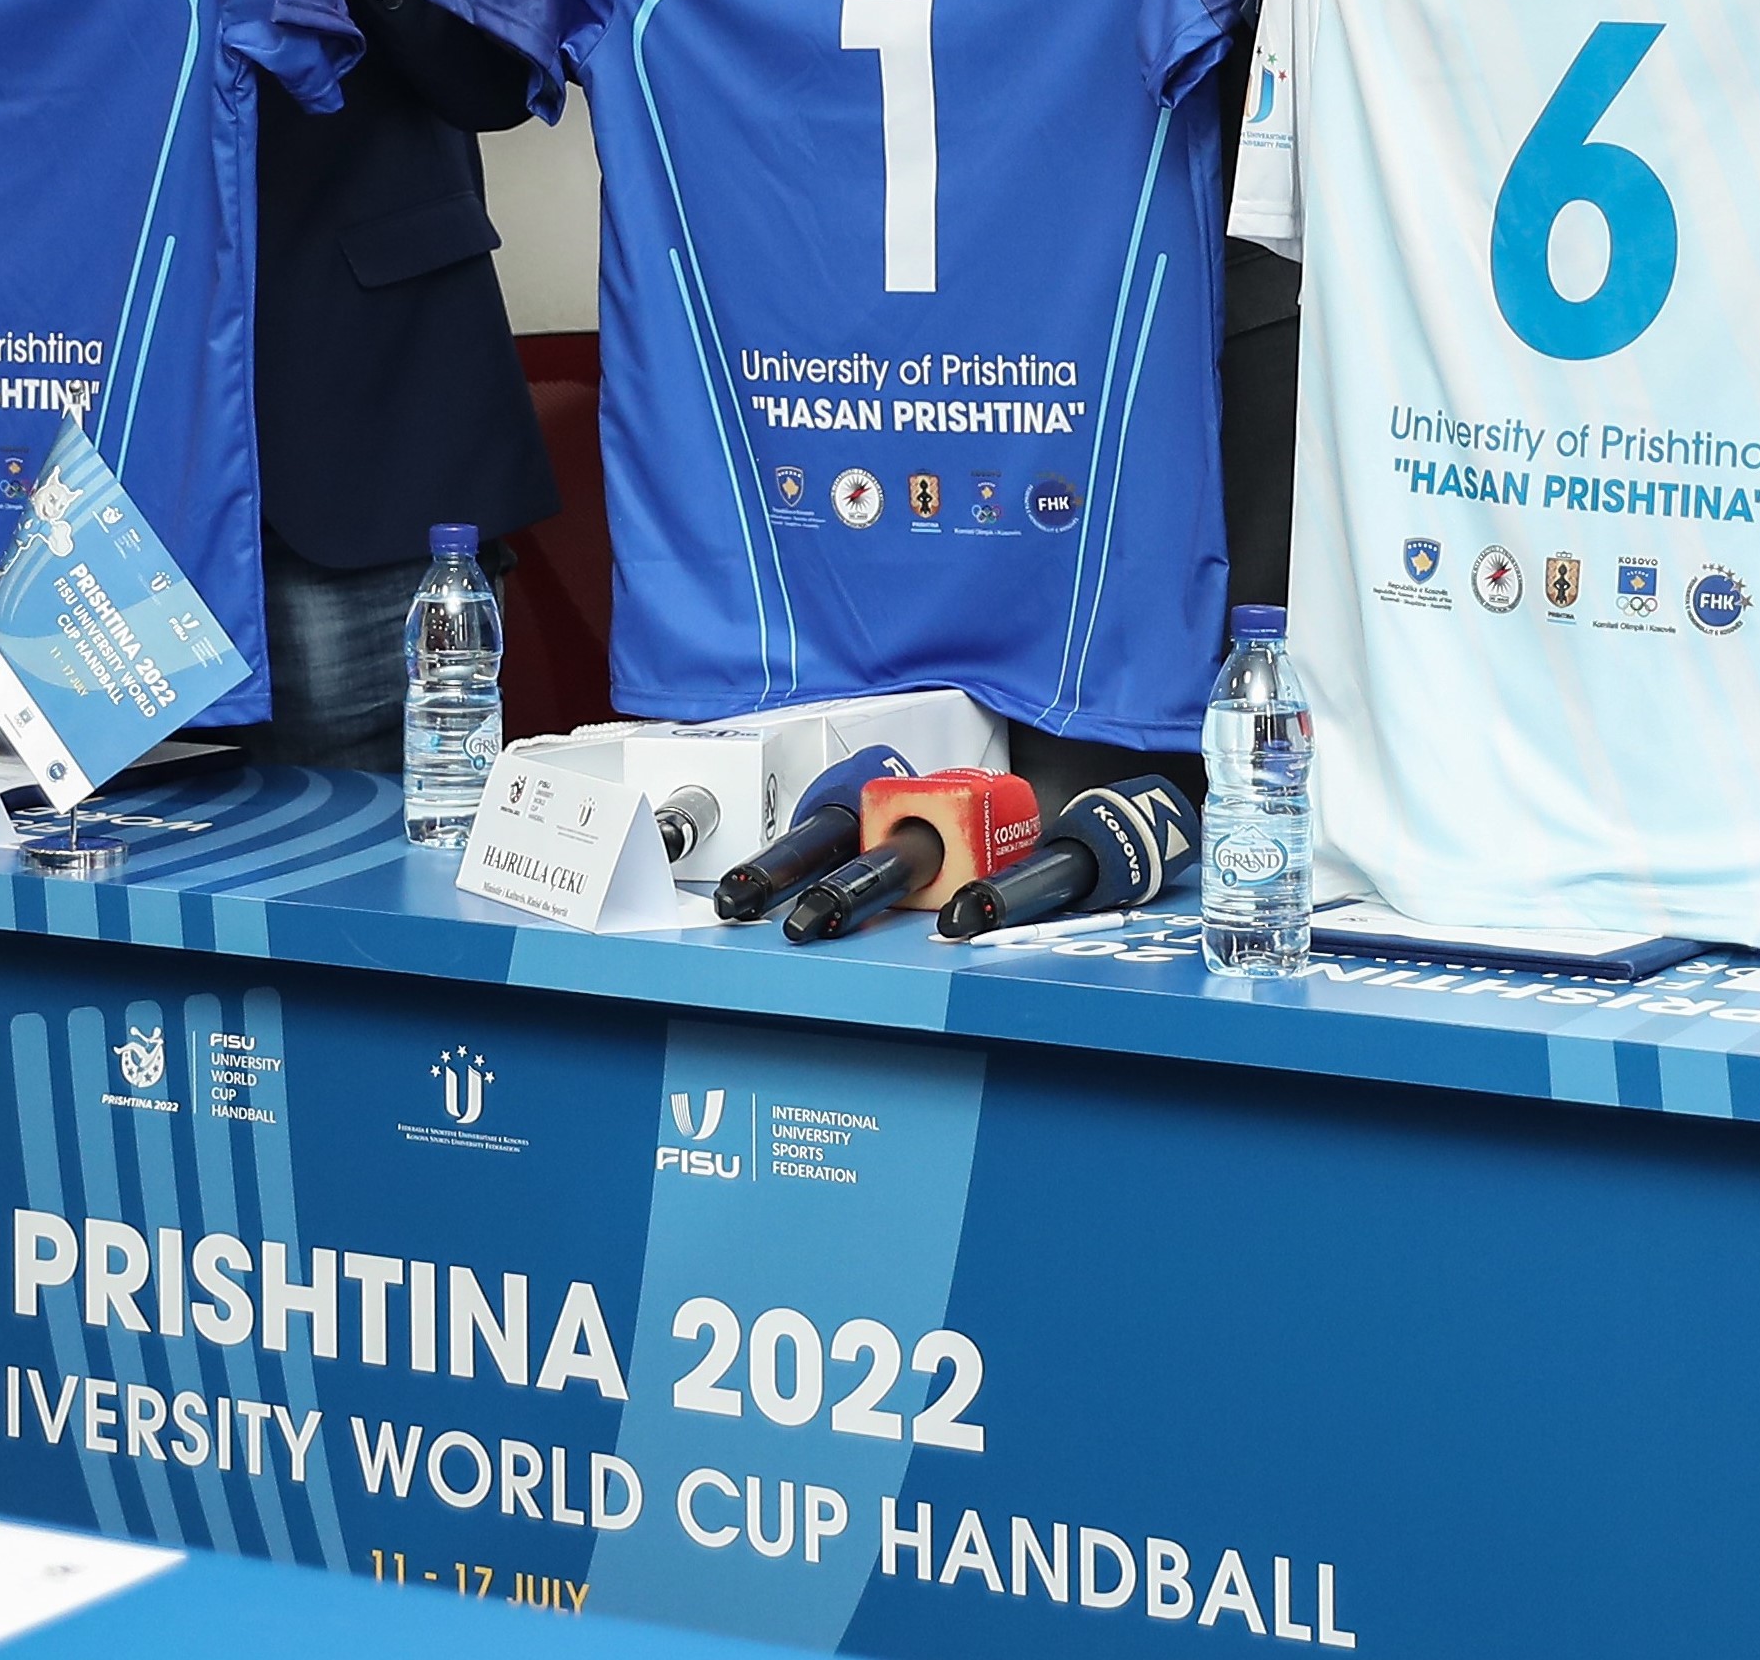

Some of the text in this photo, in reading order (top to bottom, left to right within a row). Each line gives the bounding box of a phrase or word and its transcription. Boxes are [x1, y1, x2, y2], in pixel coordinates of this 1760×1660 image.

[1489, 20, 1679, 361] 6
[741, 349, 1077, 391] University of Prishtina
[751, 395, 1086, 434] "HASAN PRISHTINA"
[1390, 405, 1545, 462] University
[1556, 423, 1590, 458] of
[1393, 457, 1530, 506] "HASAN
[1038, 496, 1070, 512] FHK
[1618, 556, 1659, 567] KOSOVO
[1699, 592, 1735, 612] FHK
[69, 563, 143, 660] PRISHTINA
[136, 658, 178, 709] 2022
[168, 616, 188, 642] FISU
[53, 577, 158, 719] FISU UNIVERSITY WORLD
[56, 613, 124, 707] CUP HANDBALL
[50, 645, 60, 658] 11
[62, 665, 72, 677] 17
[70, 676, 89, 697] JULY
[1092, 804, 1140, 885] Kosova
[482, 845, 588, 895] HAJRULLA ÇEKU
[1218, 848, 1280, 873] GRAND
[209, 1033, 256, 1051] FISU
[211, 1052, 282, 1072] UNIVERSITY
[210, 1069, 258, 1087] WORLD
[101, 1093, 179, 1112] PRISHTINA 2022
[211, 1087, 237, 1101] CUP
[211, 1104, 277, 1124] HANDBALL
[771, 1105, 880, 1131] INTERNATIONAL
[771, 1124, 851, 1146] UNIVERSITY
[656, 1146, 740, 1179] FISU
[771, 1142, 824, 1161] SPORTS
[772, 1161, 857, 1183] FEDERATION
[12, 1207, 986, 1453] PRISHTINA 2022
[349, 1414, 643, 1533] WORLD
[676, 1465, 849, 1564] CUP
[880, 1495, 1357, 1649] HANDBALL
[371, 1549, 589, 1616] 11 - 17 JULY
